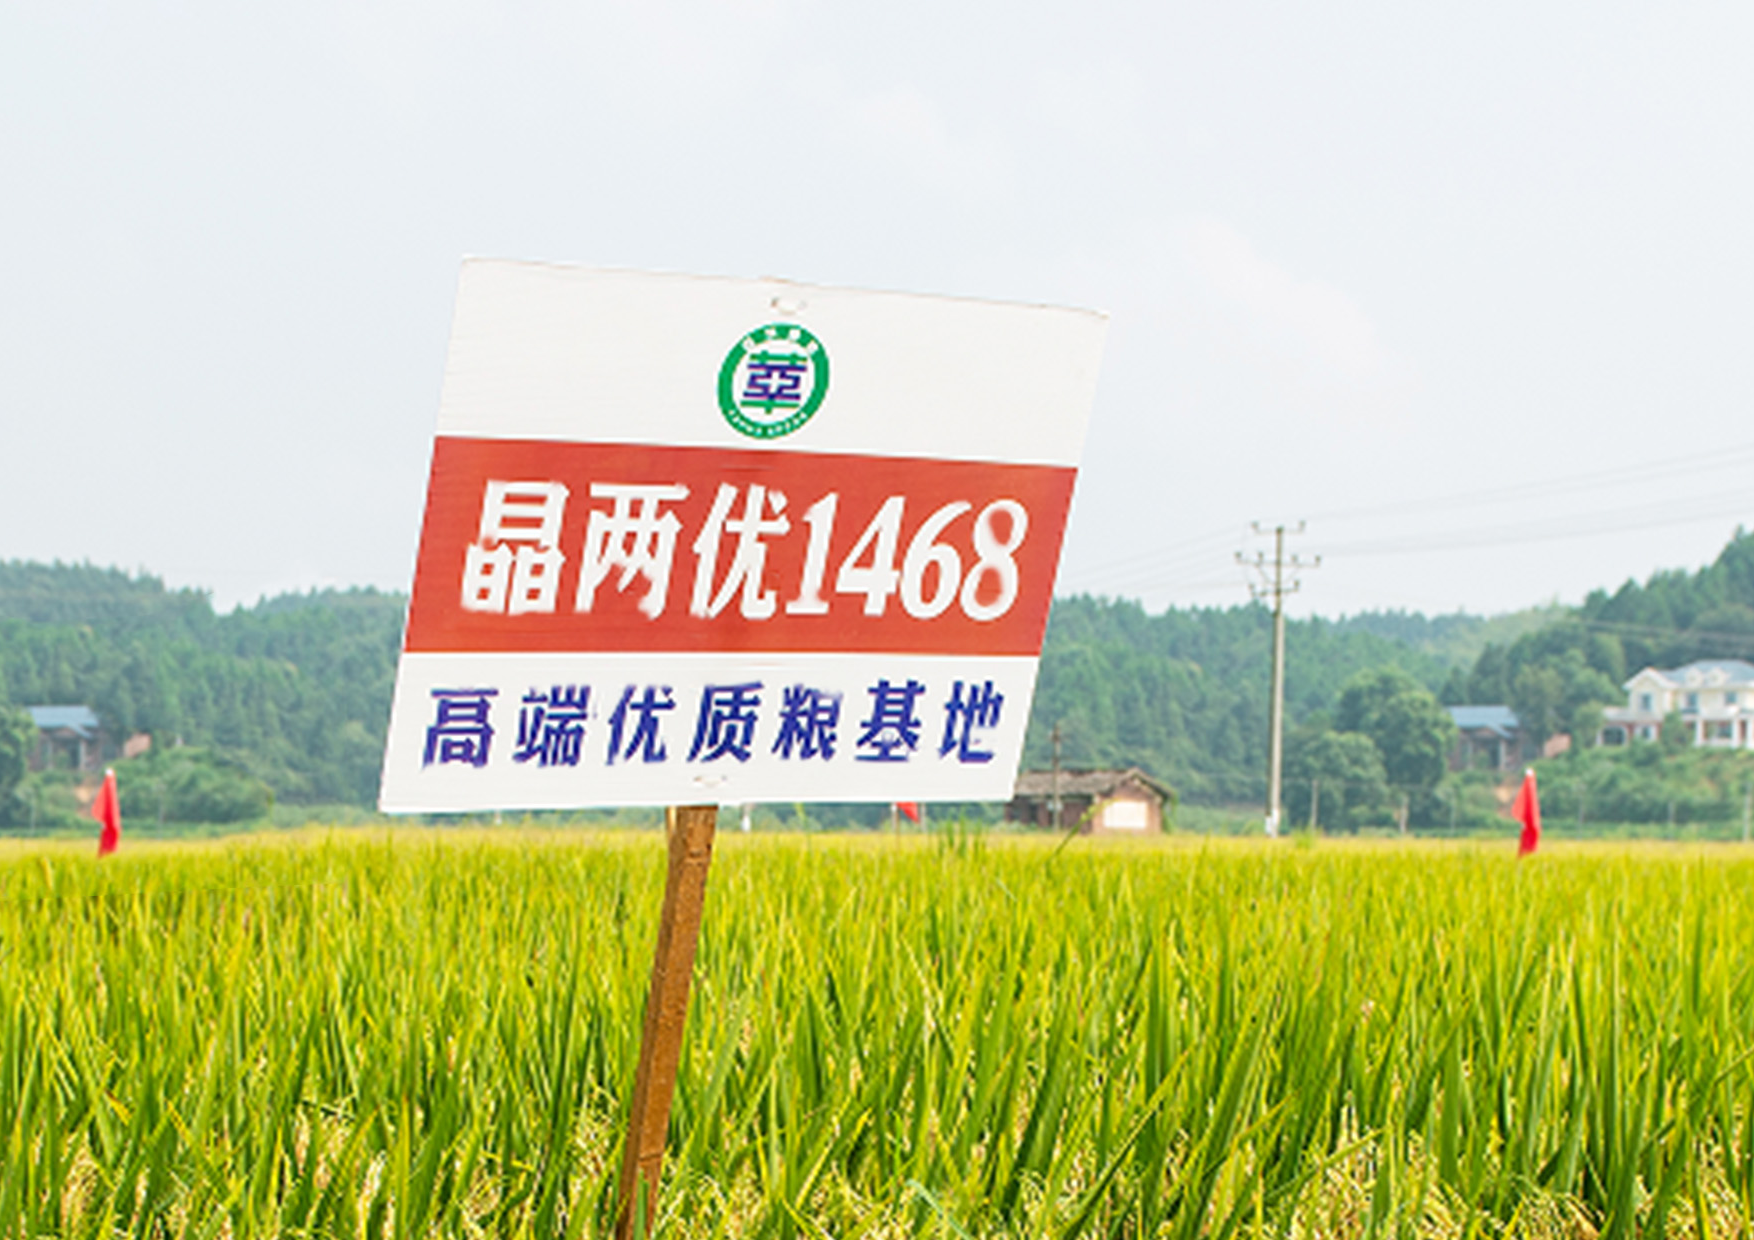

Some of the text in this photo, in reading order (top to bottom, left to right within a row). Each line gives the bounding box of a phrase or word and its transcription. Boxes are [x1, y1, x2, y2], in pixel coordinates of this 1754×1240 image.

[460, 480, 1028, 621] 晶两优1468
[422, 680, 1004, 768] 高端优质粮基地
